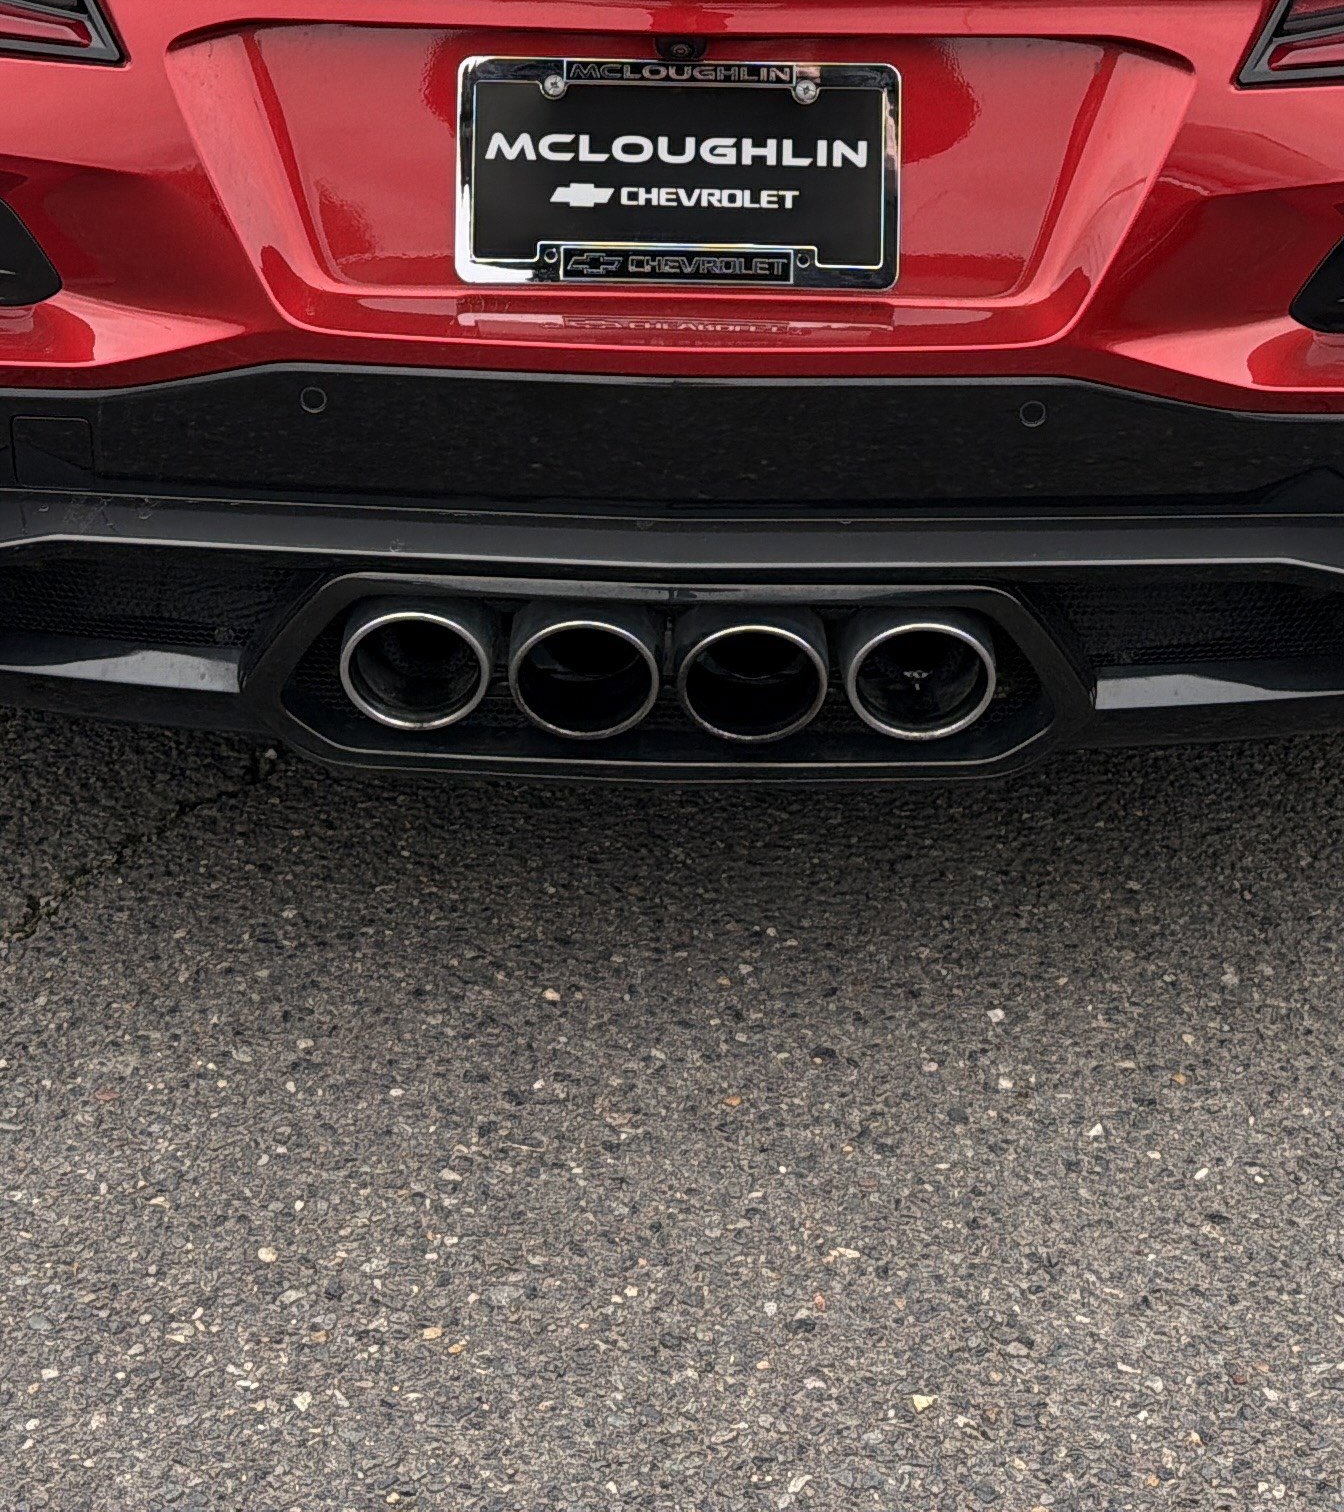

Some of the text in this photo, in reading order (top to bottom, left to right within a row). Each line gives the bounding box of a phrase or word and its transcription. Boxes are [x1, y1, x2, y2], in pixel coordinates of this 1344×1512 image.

[570, 63, 791, 81] MCLOUGHLIN
[485, 131, 869, 168] MCLOUGHLIN
[619, 186, 800, 209] CHEVROLET
[627, 254, 790, 277] CHEVROLET
